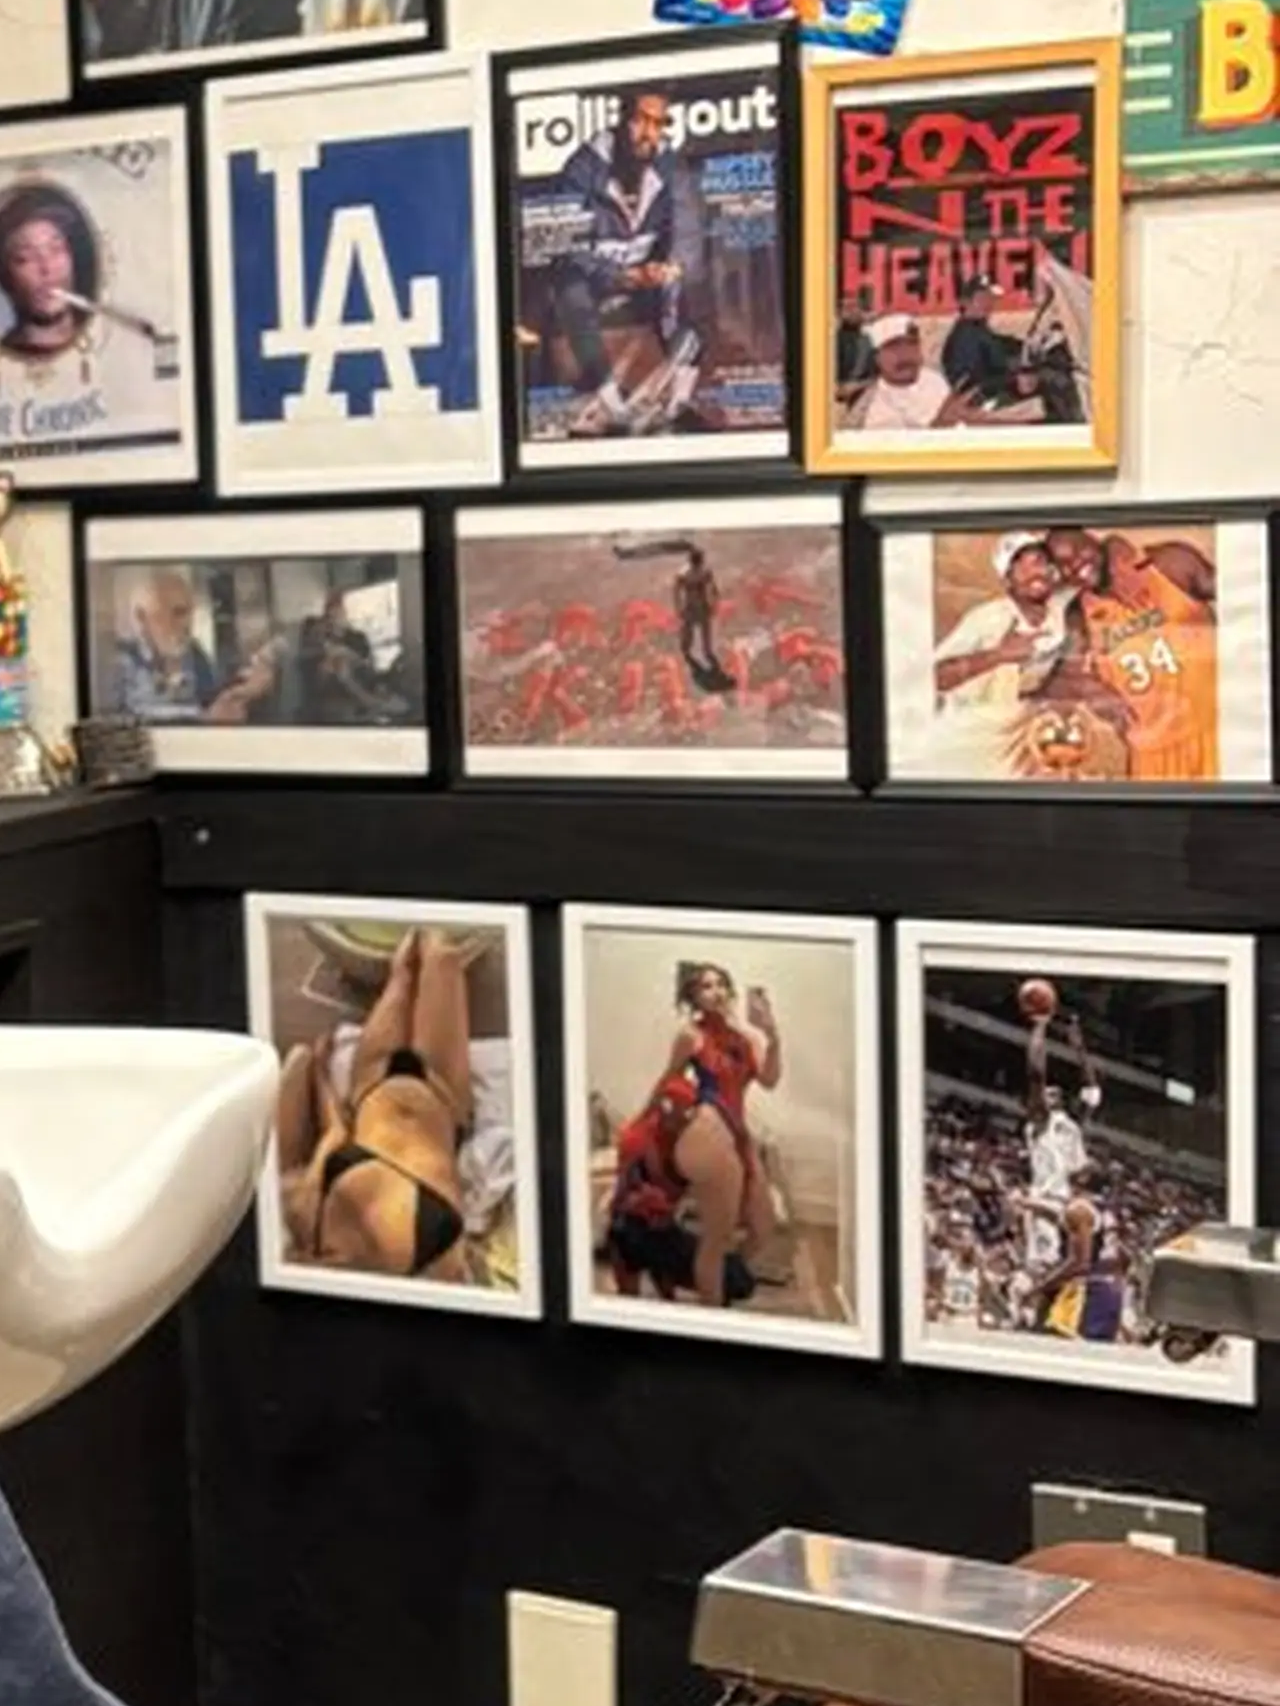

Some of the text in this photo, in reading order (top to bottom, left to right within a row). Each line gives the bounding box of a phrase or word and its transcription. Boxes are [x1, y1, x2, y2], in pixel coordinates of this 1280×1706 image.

[842, 113, 1088, 192] BOYZ
[849, 184, 1075, 240] N THE
[257, 143, 442, 422] LA
[1118, 636, 1180, 692] 34
